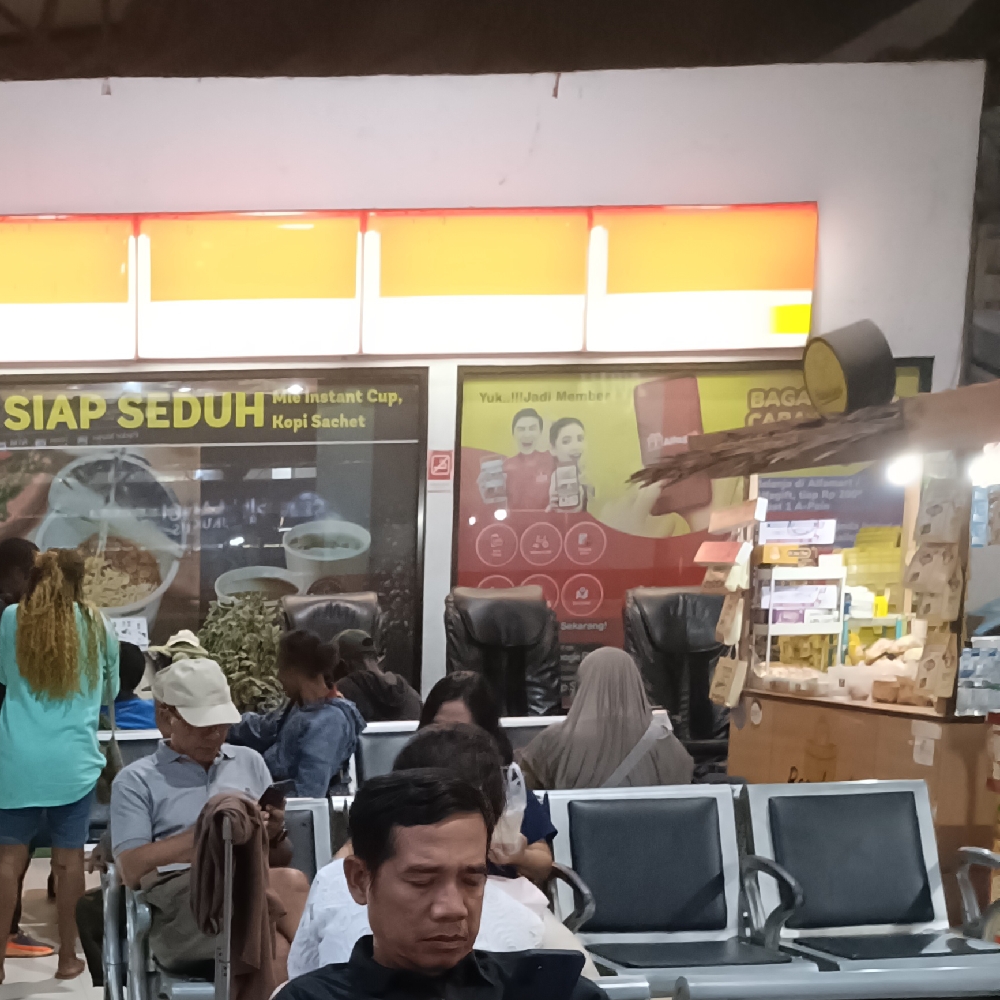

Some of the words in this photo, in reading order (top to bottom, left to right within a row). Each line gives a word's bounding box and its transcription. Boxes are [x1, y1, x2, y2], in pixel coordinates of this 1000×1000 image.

[272, 390, 301, 404] Mie
[305, 390, 363, 404] Instant
[366, 388, 403, 407] Cup,
[556, 390, 611, 402] Member
[4, 394, 107, 430] SIAP
[117, 392, 265, 429] SEDUH
[272, 413, 308, 433] Kopi
[310, 413, 366, 428] Sachet
